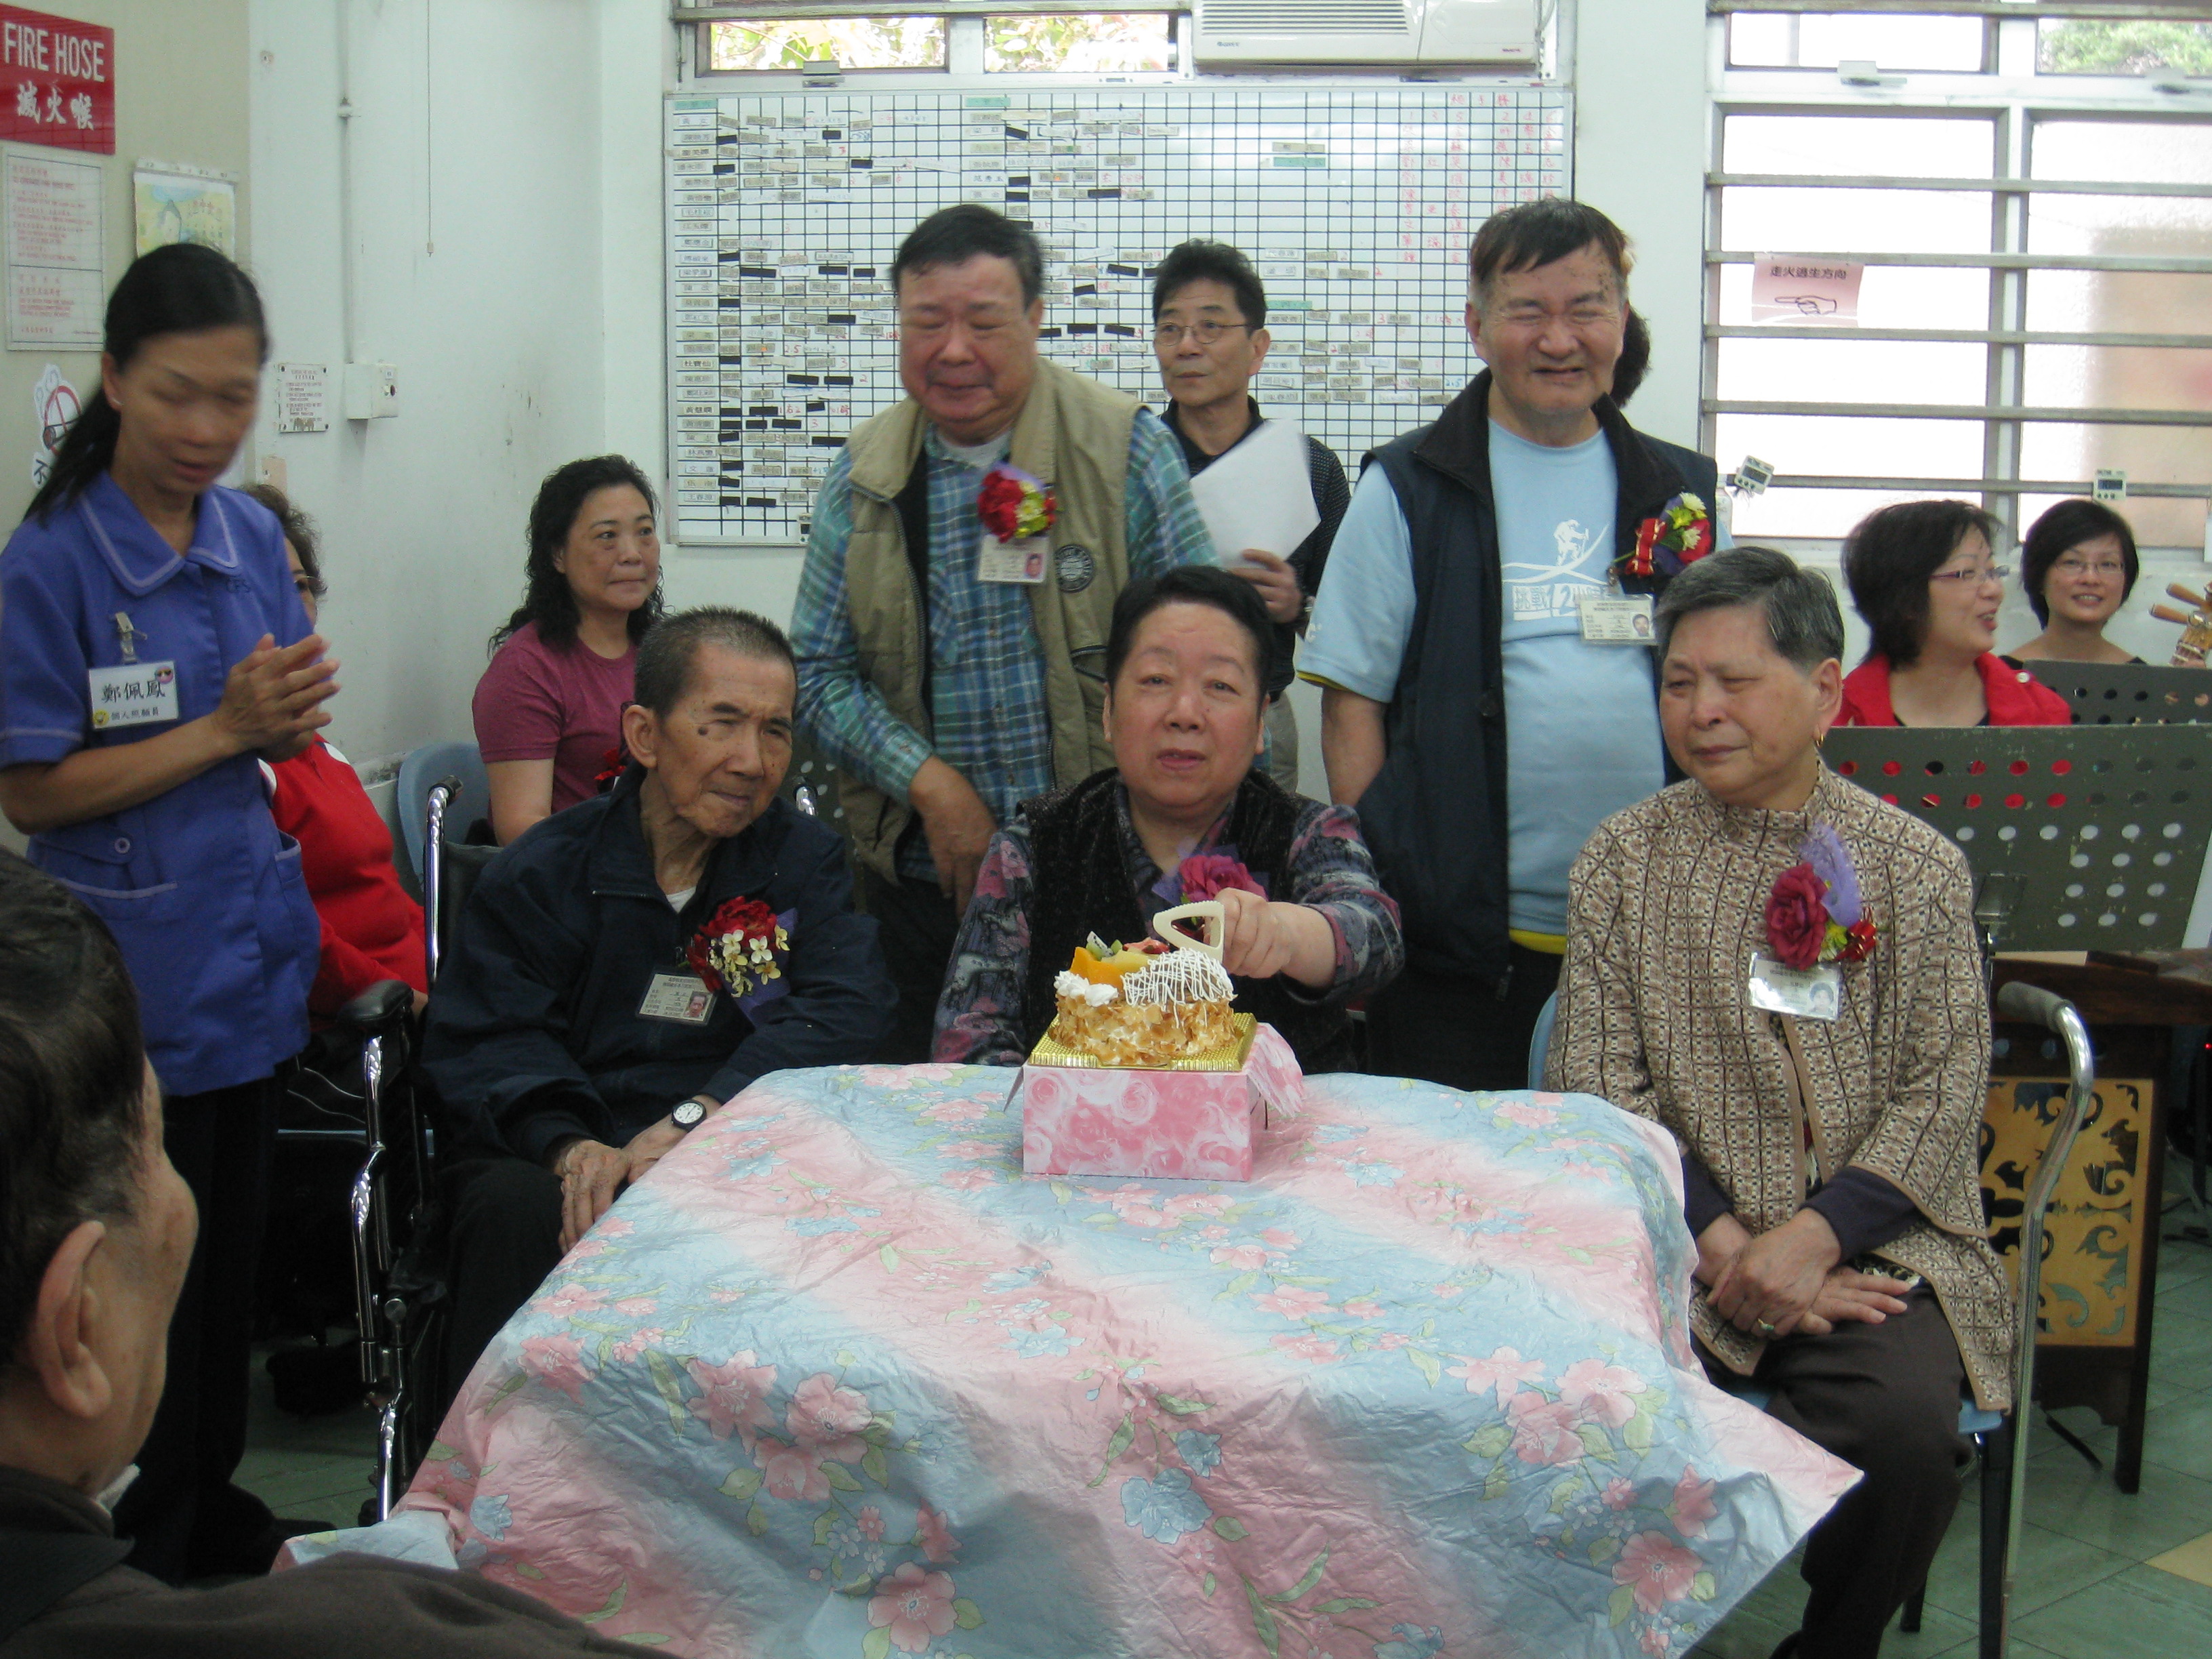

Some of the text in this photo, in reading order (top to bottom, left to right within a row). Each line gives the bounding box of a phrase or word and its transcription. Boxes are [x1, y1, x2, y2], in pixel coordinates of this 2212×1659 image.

[4, 22, 105, 83] FIRE HOSE
[16, 80, 94, 131] 滅火喉
[1771, 266, 1847, 279] 走火逃生方向
[102, 679, 166, 703] 鄭佩鳳
